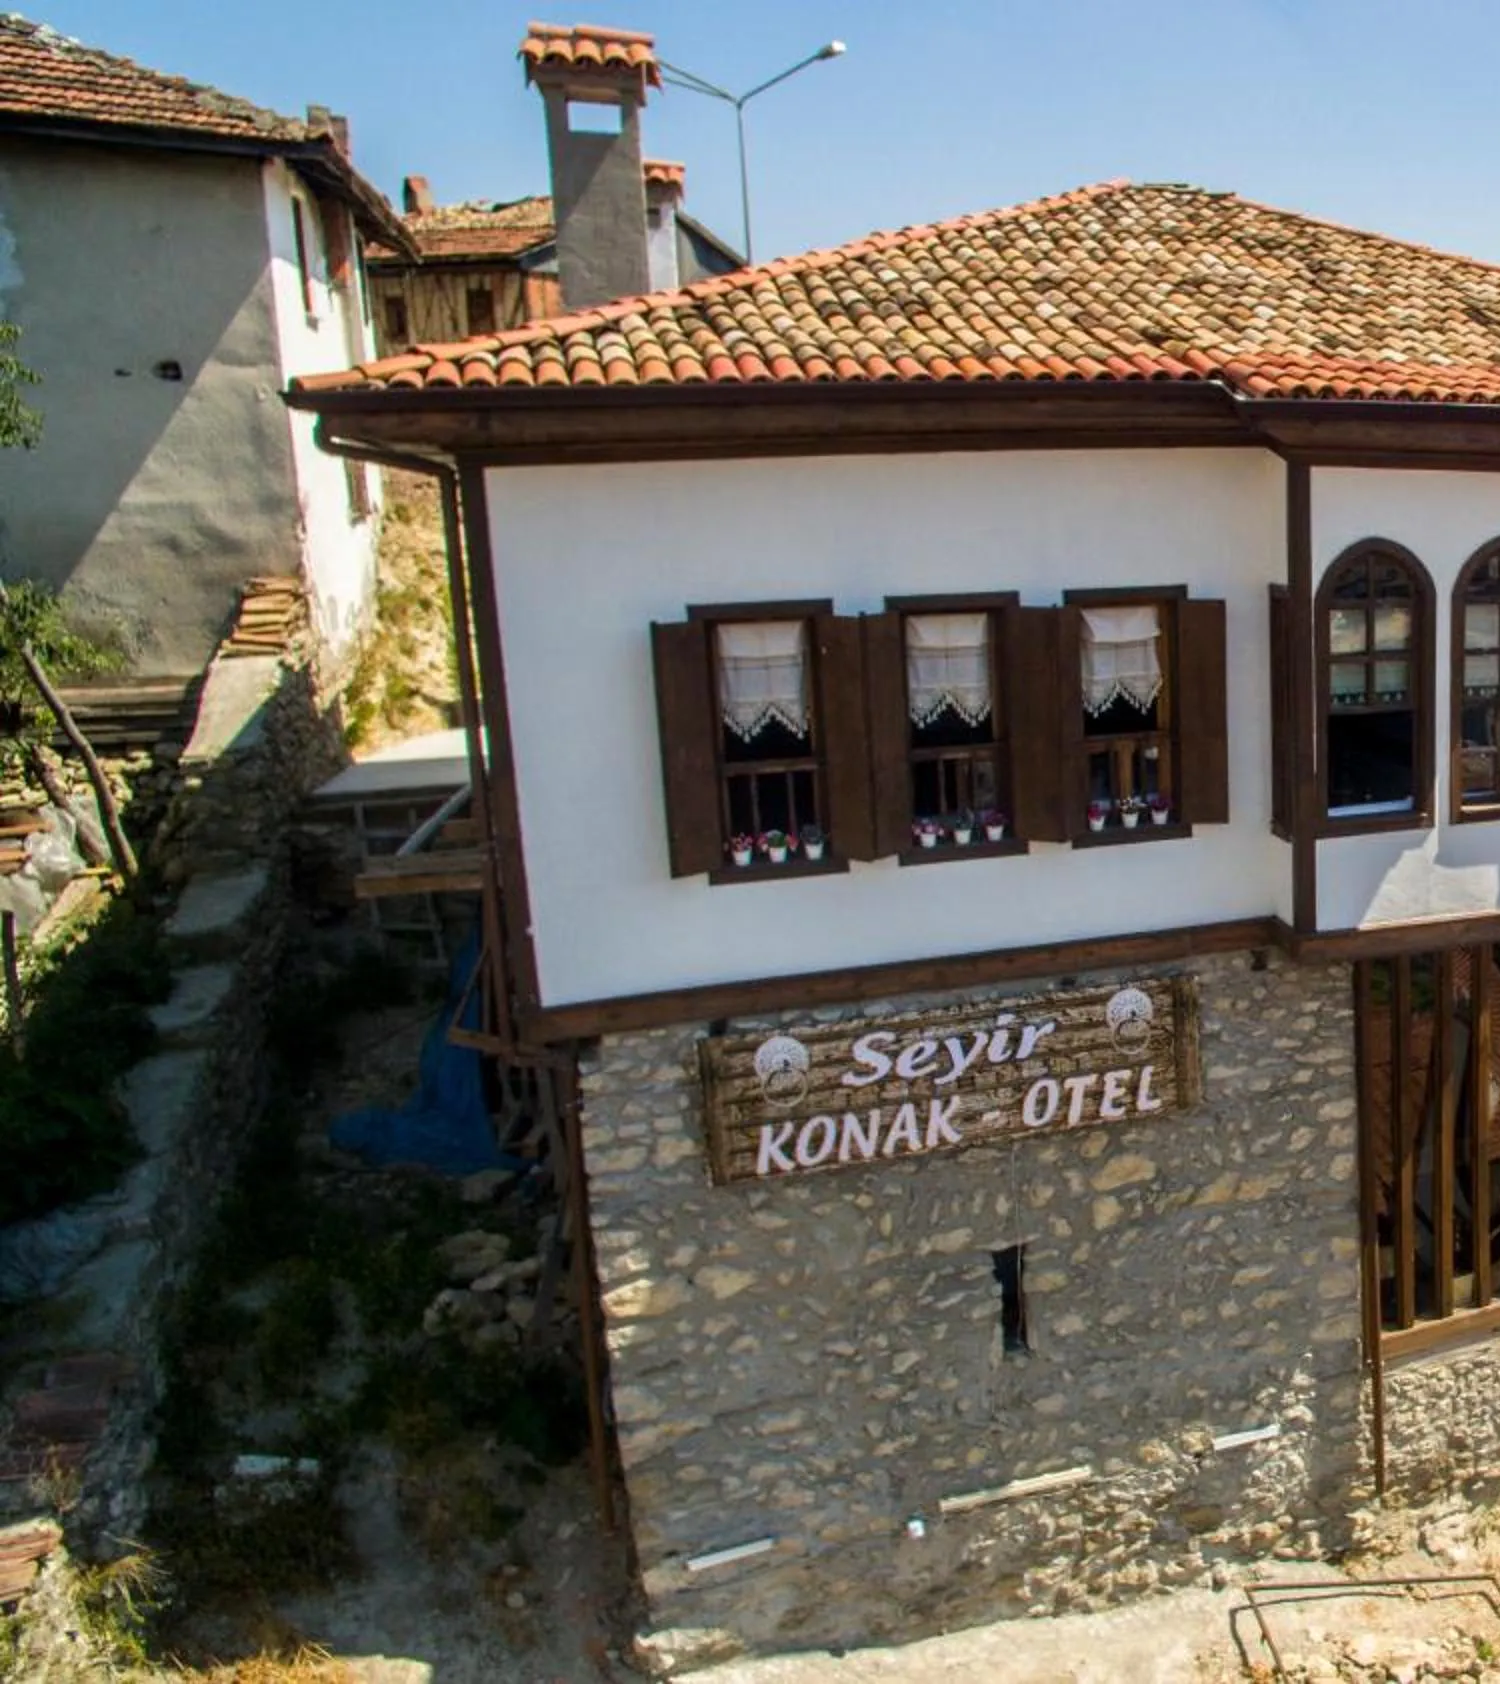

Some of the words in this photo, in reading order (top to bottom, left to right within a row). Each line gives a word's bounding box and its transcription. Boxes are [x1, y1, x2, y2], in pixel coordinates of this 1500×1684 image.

[842, 1013, 1056, 1086] Seyir
[756, 1095, 962, 1175] KONAK
[1022, 1065, 1162, 1129] OTEL
